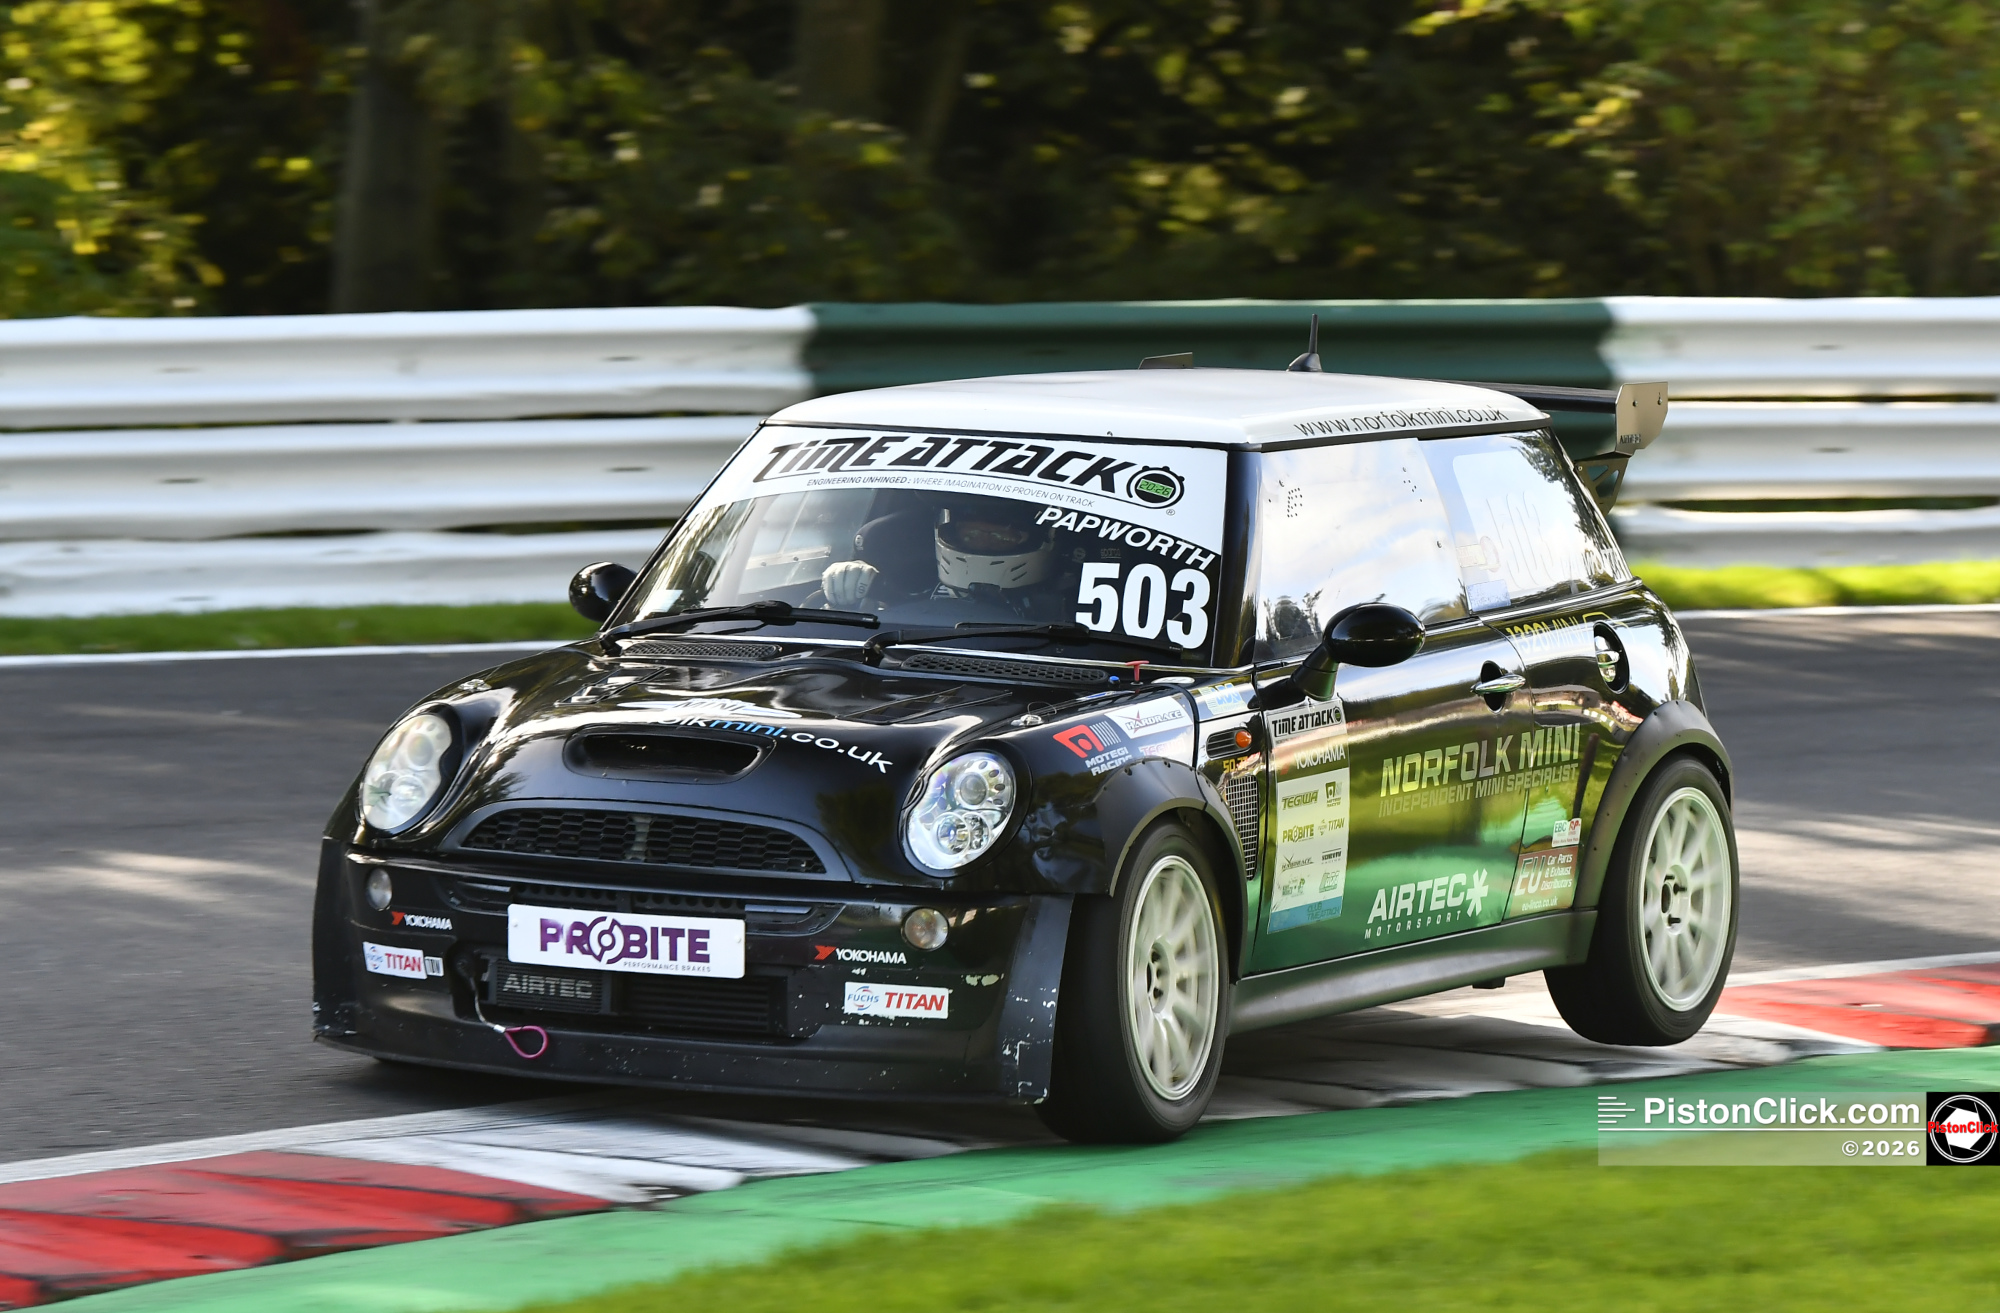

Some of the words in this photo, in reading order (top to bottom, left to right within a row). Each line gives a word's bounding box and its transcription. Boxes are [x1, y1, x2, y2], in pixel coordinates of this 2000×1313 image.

[1294, 405, 1510, 437] www.norfolkmini.co.uk
[887, 437, 1138, 494] ATTACK
[807, 476, 861, 486] ENGINEERING
[913, 477, 943, 486] WHERE
[944, 478, 1002, 492] IMAGINATION
[1002, 483, 1011, 493] IS
[1012, 485, 1048, 499] PROVEN
[1049, 491, 1063, 502] ON
[1065, 493, 1095, 507] TRACK
[1139, 480, 1171, 497] 20:26
[1035, 507, 1215, 571] PAPWORTH
[1076, 562, 1211, 649] 503
[1125, 710, 1182, 730] HARDRACE
[1298, 708, 1334, 730] ATTACK
[1085, 747, 1129, 768] MOTEGI
[1293, 743, 1346, 770] YOKOHAMA
[1380, 735, 1514, 798] NORFOLK
[1518, 722, 1581, 770] MINI
[1282, 789, 1319, 810] TEGIWA
[1378, 782, 1473, 818] INDEPENDENT
[1475, 776, 1504, 799] MINI
[1506, 762, 1579, 792] SPECIALIST
[1282, 823, 1314, 843] PROBITE
[1328, 817, 1345, 831] TITAN
[1557, 853, 1573, 864] Parts
[1514, 855, 1546, 897] EU
[1550, 866, 1572, 878] Exhaust
[1367, 872, 1467, 925] AIRTEC
[403, 913, 453, 930] YOKOHAMA
[1364, 910, 1462, 939] MOTORSPORT
[540, 915, 710, 965] PROBITE
[384, 952, 421, 973] TITAN
[623, 960, 679, 972] PERFORMANCE
[681, 963, 711, 973] BRAKES
[835, 948, 907, 965] YOKOHAMA
[503, 973, 593, 999] AIRTEC
[847, 993, 879, 1003] FUCHS
[884, 991, 945, 1011] TITAN
